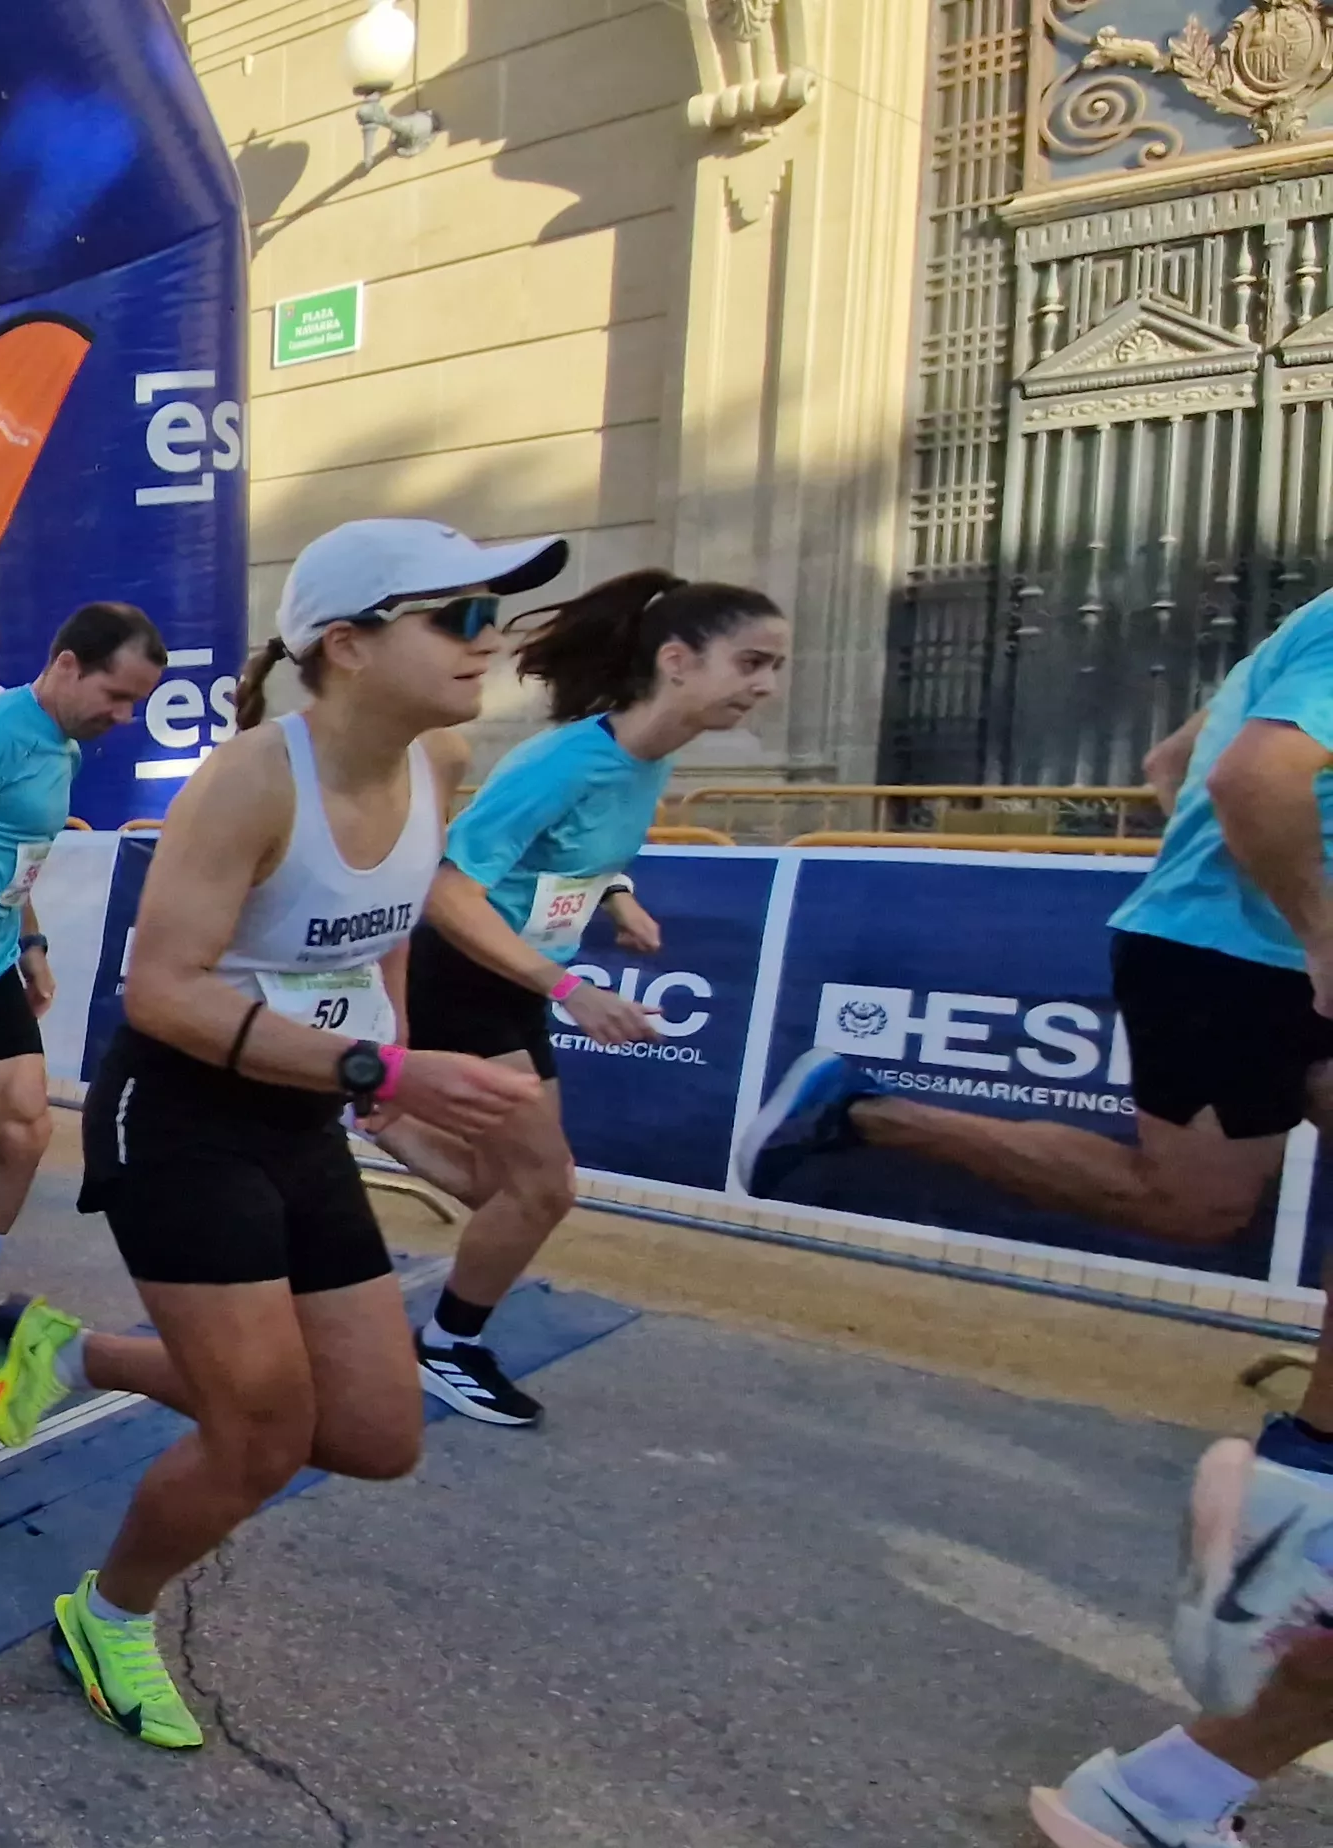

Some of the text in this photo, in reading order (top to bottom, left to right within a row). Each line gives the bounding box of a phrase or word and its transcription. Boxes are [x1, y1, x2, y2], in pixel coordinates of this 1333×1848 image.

[302, 307, 334, 324] PLAZA
[295, 318, 341, 338] NAVARRA
[547, 892, 586, 918] 563
[310, 996, 350, 1030] 50
